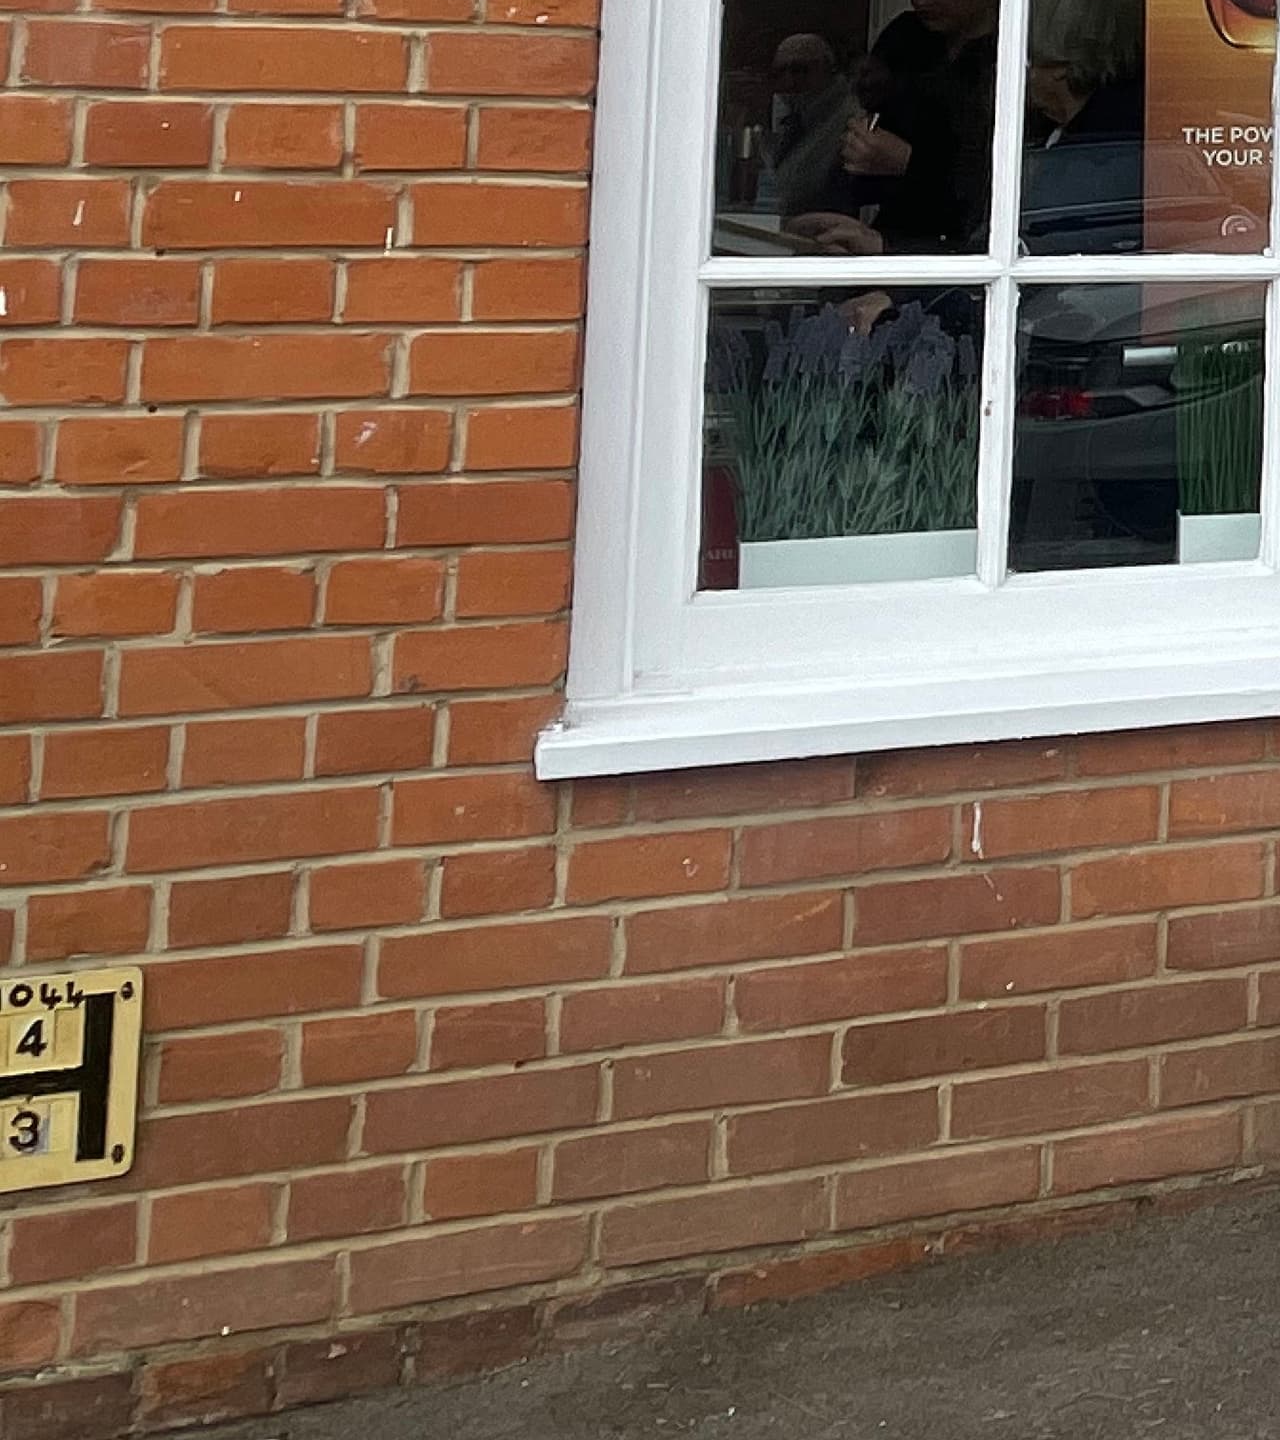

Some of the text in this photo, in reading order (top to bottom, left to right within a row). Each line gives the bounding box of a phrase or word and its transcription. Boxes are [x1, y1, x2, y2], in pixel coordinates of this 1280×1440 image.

[1182, 126, 1225, 144] THE
[1203, 148, 1263, 166] YOUR
[16, 1019, 48, 1057] 4
[8, 1110, 41, 1154] 3
